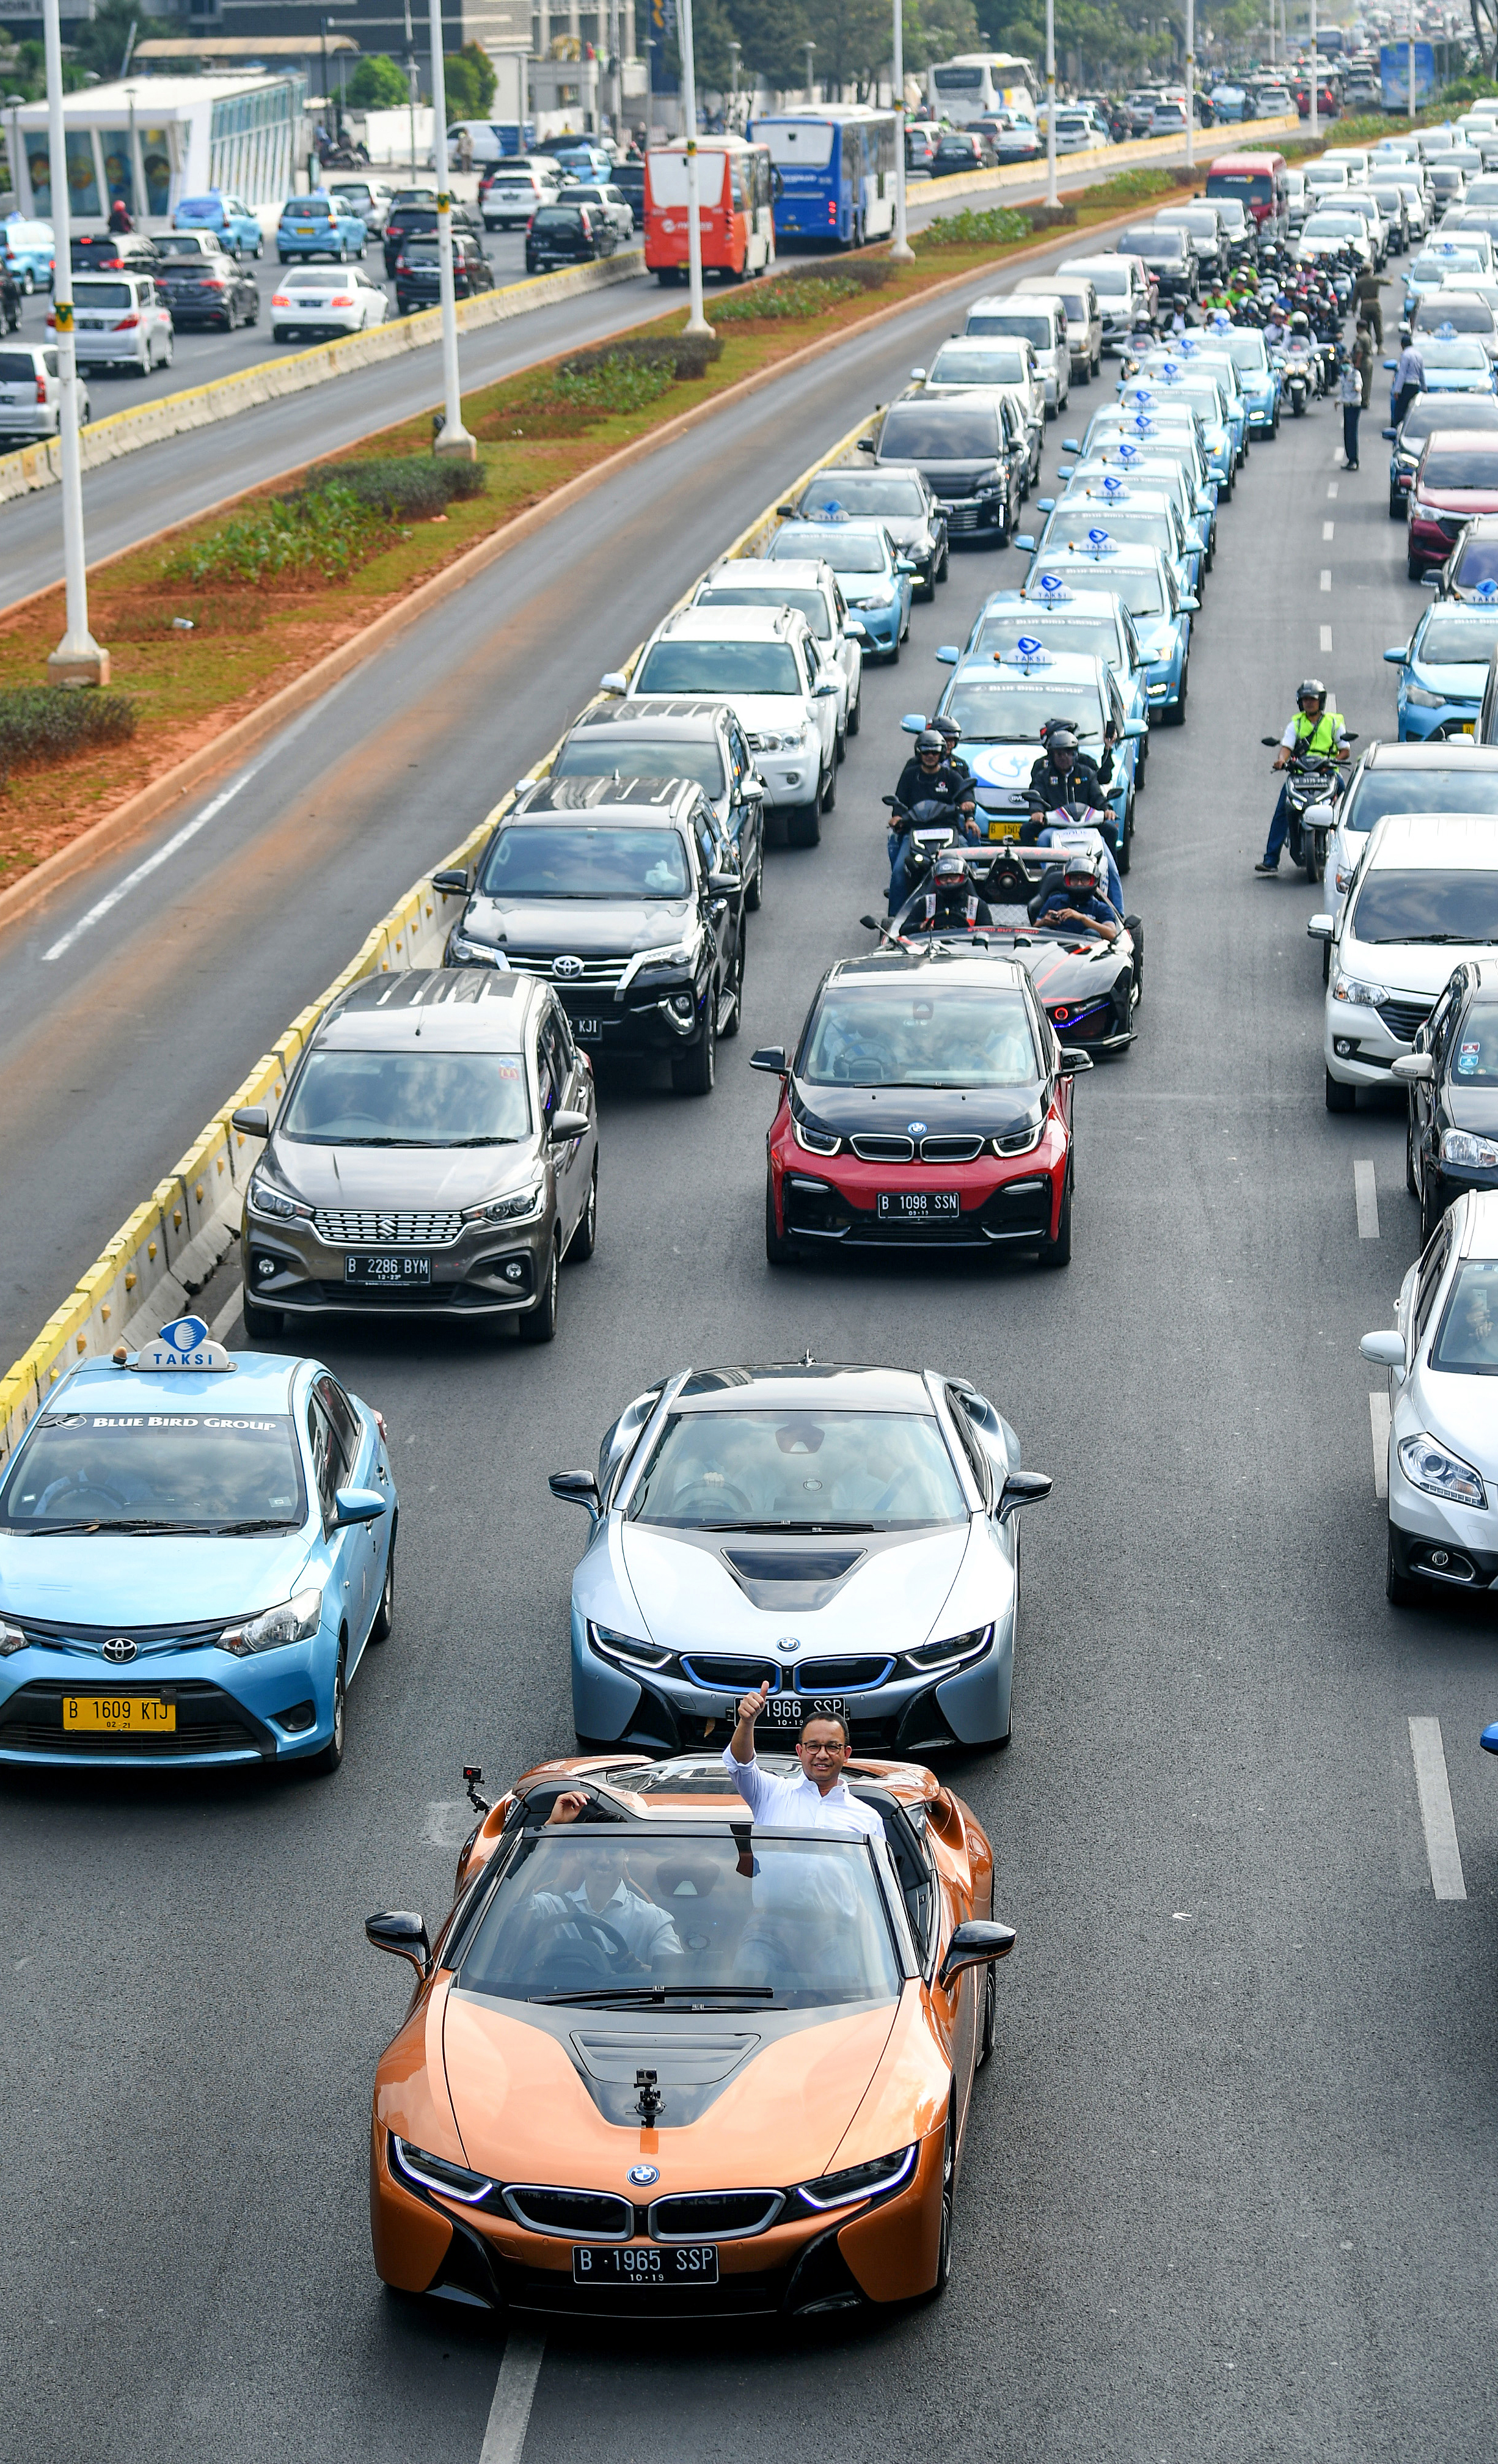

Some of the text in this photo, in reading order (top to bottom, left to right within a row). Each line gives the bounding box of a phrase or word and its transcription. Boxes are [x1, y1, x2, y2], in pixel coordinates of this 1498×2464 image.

[579, 1020, 597, 1033] KJI
[882, 1195, 957, 1210] B 1098 SSN
[348, 1258, 428, 1274] B 2286 BYM
[153, 1353, 213, 1365] TAKSI
[92, 1417, 277, 1431] BLUE BIRD GROUP
[69, 1701, 168, 1720] B 1609 KTJ
[765, 1700, 802, 1718] 1966
[580, 2248, 713, 2271] B 1965 SSP
